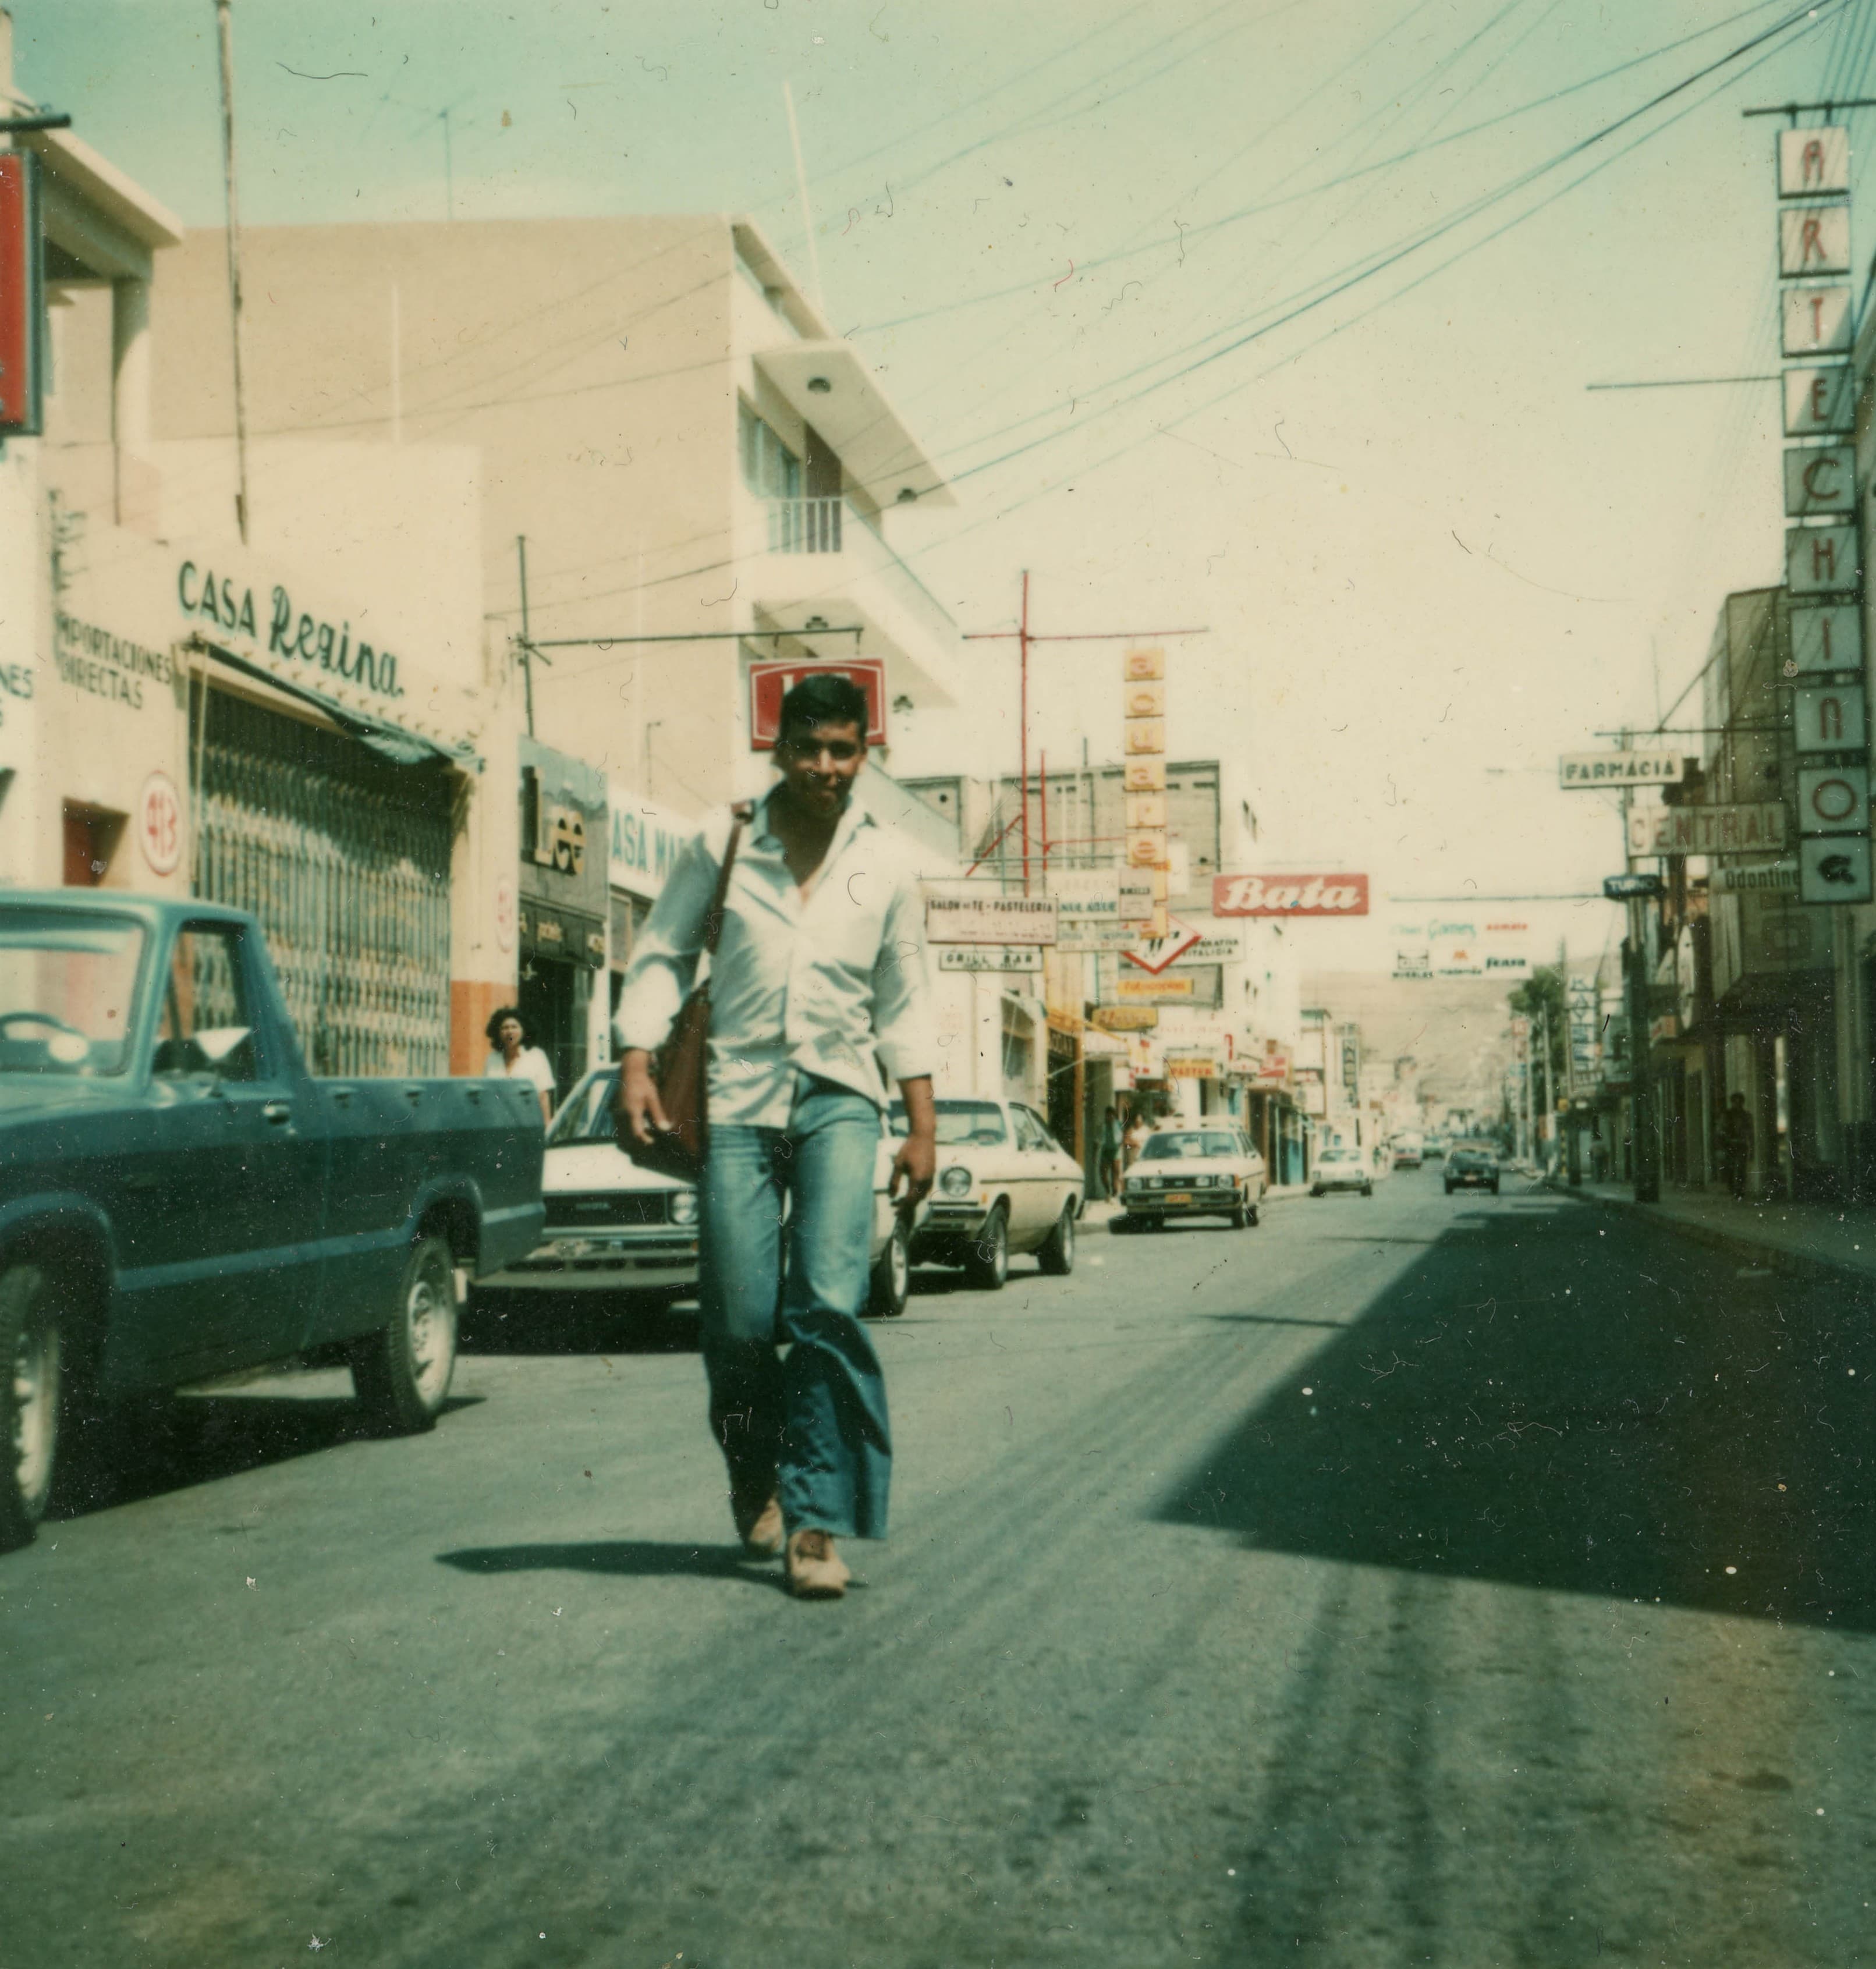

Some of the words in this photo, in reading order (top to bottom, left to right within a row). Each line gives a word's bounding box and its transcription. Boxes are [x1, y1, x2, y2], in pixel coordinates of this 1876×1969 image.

[179, 560, 257, 638] CASA
[59, 650, 143, 711] DIRECTAS
[1565, 760, 1676, 780] FARMACIA
[612, 808, 648, 872] ASA
[654, 828, 686, 877] MA
[1630, 813, 1782, 850] CENTRAL
[973, 900, 983, 911] TE
[994, 901, 1052, 913] PASTELERIA
[1219, 877, 1361, 911] Bata
[946, 953, 987, 964] GRILL
[1003, 954, 1033, 964] BAR
[1194, 938, 1239, 948] ERATIVA
